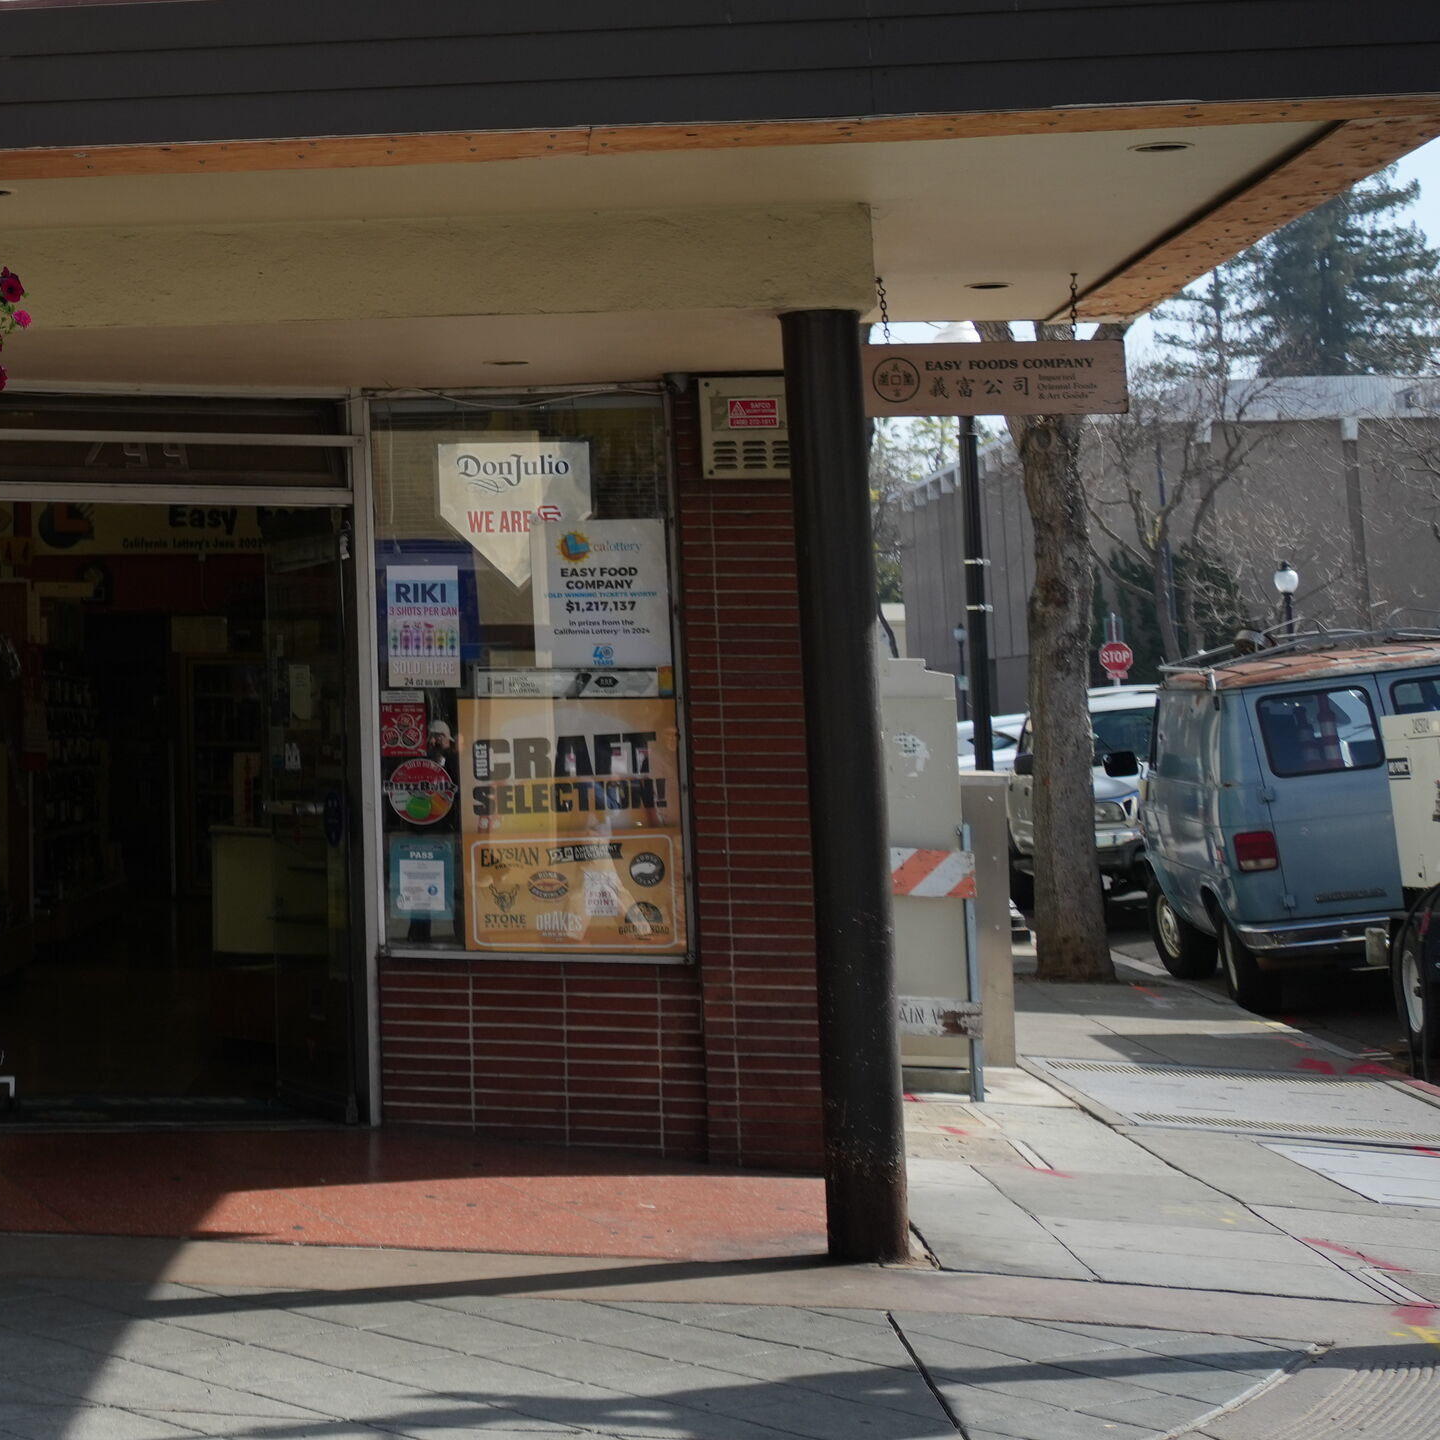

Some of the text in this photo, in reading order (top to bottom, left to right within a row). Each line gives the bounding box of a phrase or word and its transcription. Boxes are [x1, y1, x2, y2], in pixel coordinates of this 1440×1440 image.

[925, 358, 1094, 371] EASY FOODS COMPANY
[929, 377, 1030, 399] 義富公司
[169, 505, 237, 536] Easy
[467, 511, 495, 533] WE
[499, 511, 532, 533] ARE
[560, 566, 638, 578] EASY FOOD
[566, 579, 633, 590] COMPANY
[395, 583, 446, 603] RIKI
[389, 606, 457, 616] 3 SHOTS PER CAN
[566, 600, 636, 613] $1,217,137
[554, 628, 590, 636] California
[1102, 650, 1130, 664] STOP
[393, 661, 454, 674] SOLD HERE
[473, 732, 657, 781] HUGE CRAFT
[473, 778, 667, 816] SELECTION!
[409, 851, 434, 859] PASS
[481, 847, 541, 867] ELYSIAN
[485, 914, 526, 924] STONE
